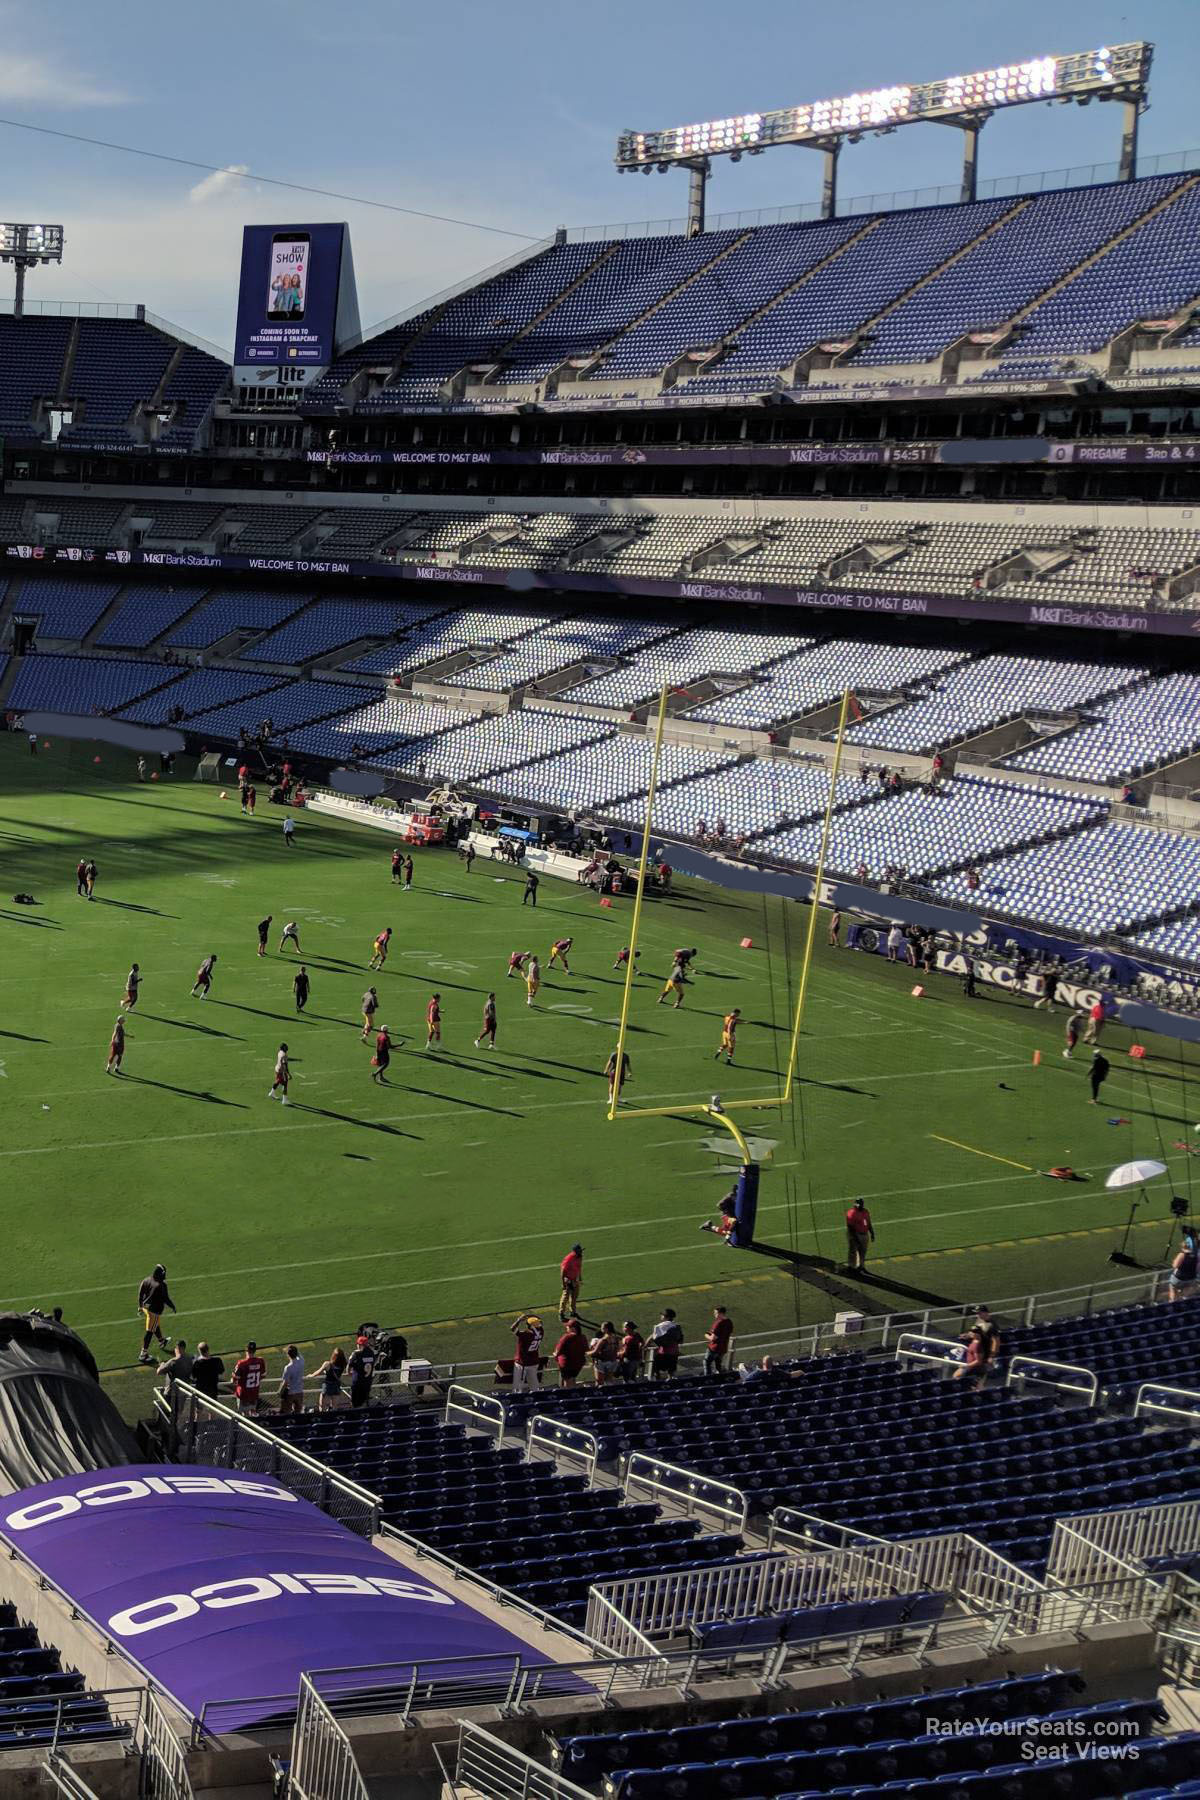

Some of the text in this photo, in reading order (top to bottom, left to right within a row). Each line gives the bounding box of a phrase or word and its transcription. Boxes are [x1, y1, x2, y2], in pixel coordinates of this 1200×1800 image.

[276, 253, 304, 263] SHOW
[277, 367, 306, 385] Lite
[306, 451, 328, 462] M&T
[348, 452, 381, 463] Stadium
[393, 453, 490, 464] WELCOME TO M&T BAN
[540, 453, 612, 464] M&T Bank Stadium
[790, 449, 878, 463] M&T Bank Stadium
[893, 449, 927, 461] 54:51
[1080, 447, 1127, 459] PREGAME
[1145, 446, 1196, 459] 3RD & 4
[143, 553, 221, 567] M&T Bank Stadium
[249, 558, 349, 573] WELCOME TO M&T BAN
[416, 567, 483, 582] M&T Bank Stadium
[680, 583, 704, 597] M&T
[704, 584, 727, 598] Bank
[797, 591, 927, 612] WELCOME TO M&T BAN
[1029, 606, 1147, 630] M&T Bank Stadium
[246, 1371, 260, 1388] 21
[5, 1476, 300, 1530] GEICO
[108, 1573, 457, 1636] GEICO
